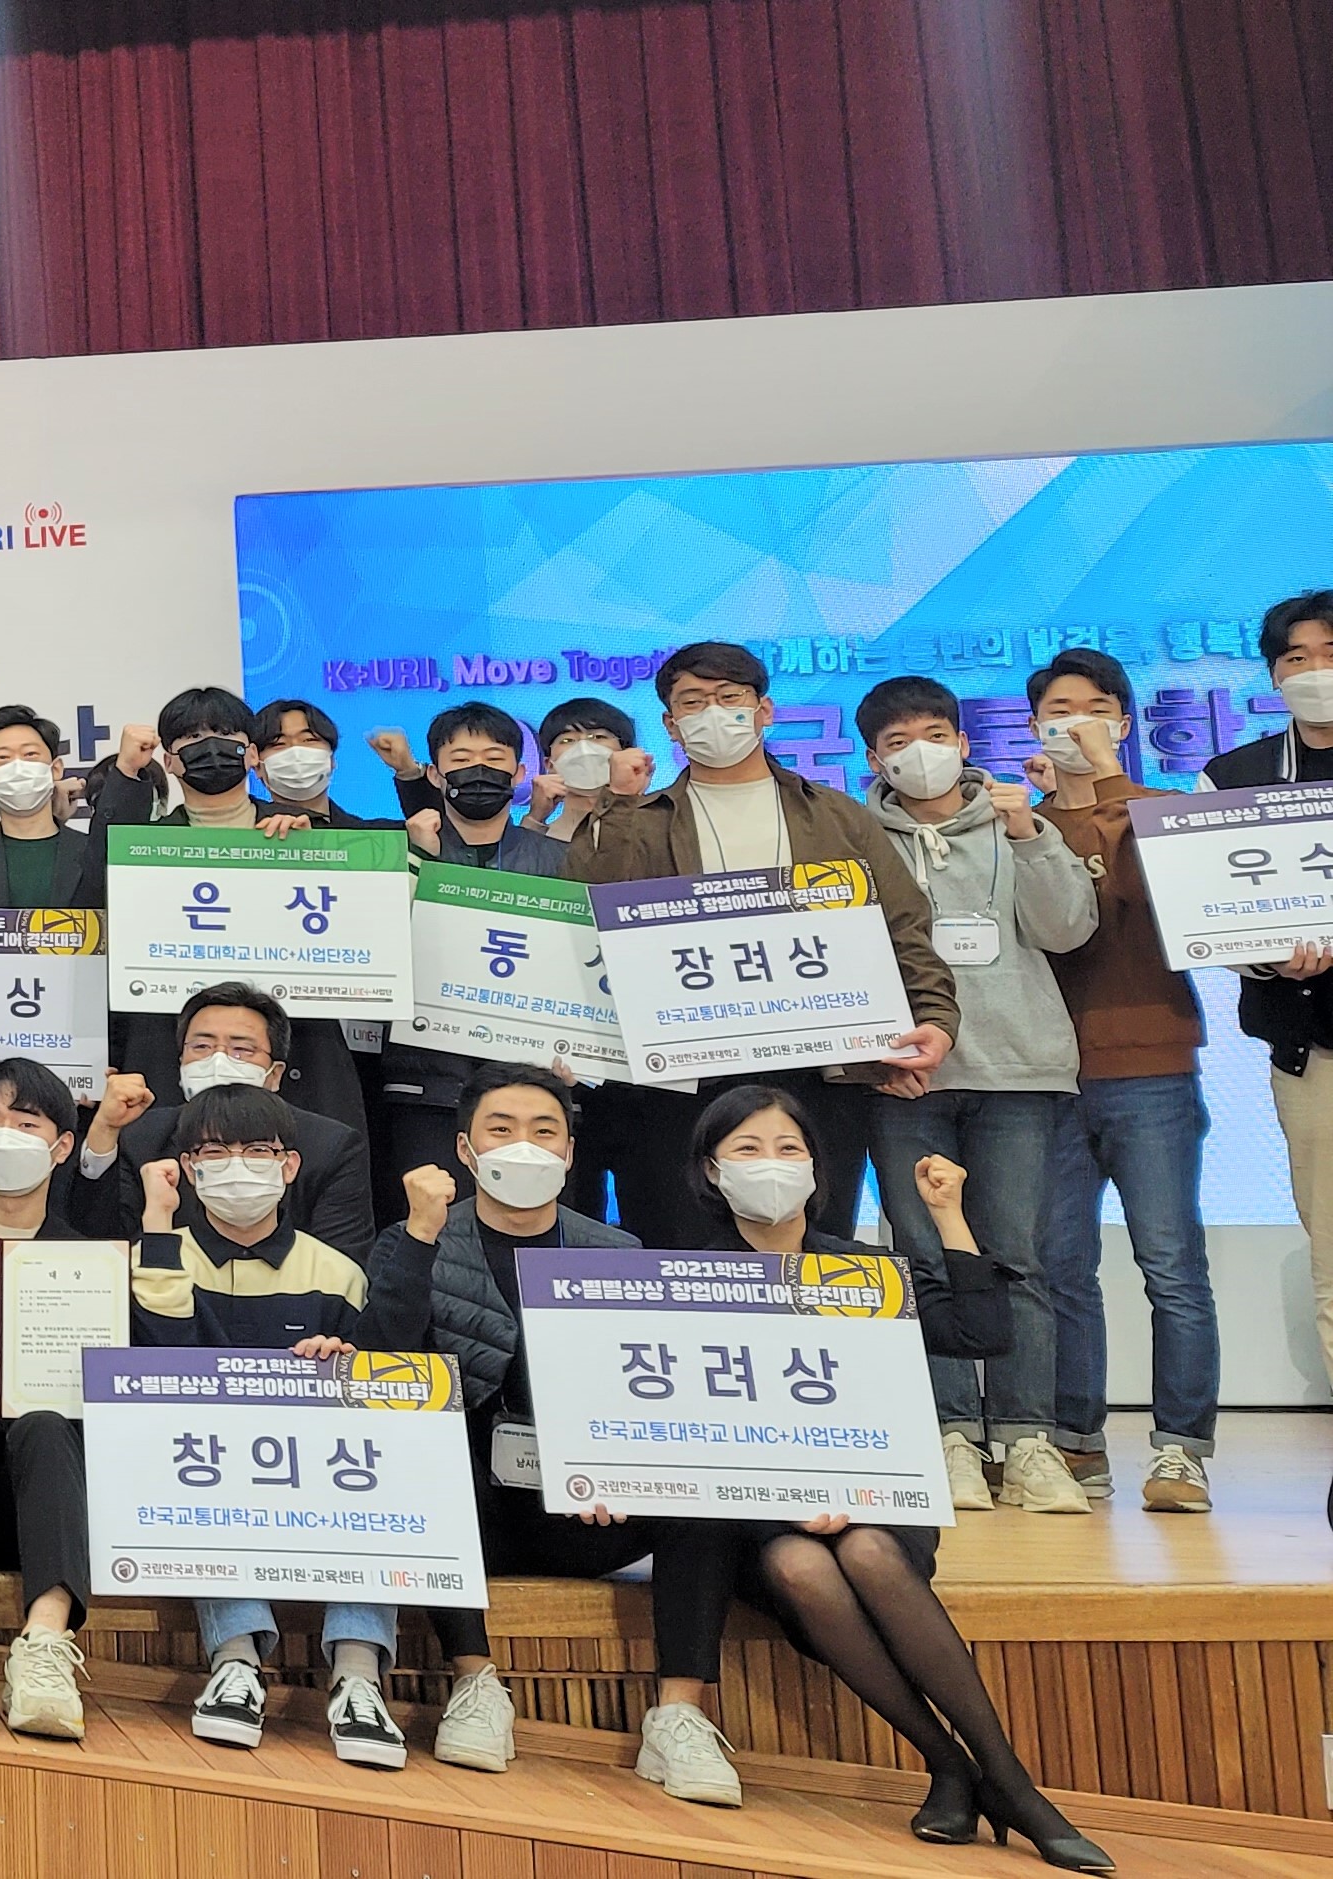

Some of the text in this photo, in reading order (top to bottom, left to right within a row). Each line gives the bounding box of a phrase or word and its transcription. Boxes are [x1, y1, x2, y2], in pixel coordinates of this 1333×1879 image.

[24, 524, 86, 549] LIVE
[453, 652, 557, 686] Move
[183, 847, 347, 862] 교과 캡스톤디자인 교내 경진대회
[693, 876, 769, 896] 2021학년도
[491, 891, 514, 904] 교과
[516, 894, 585, 916] 캡스톤디자인
[617, 884, 854, 923] K+별별상상 창업아이디어 경진대회
[1202, 895, 1326, 918] 한국교통대학교
[27, 932, 83, 948] 경진대회
[149, 943, 371, 965] 한국교통대학교 LINC+사업단장상
[441, 982, 528, 1010] 한국교통대학교
[657, 991, 870, 1025] 한국교통대학교 LINC+사업단장상
[432, 1022, 460, 1035] 교육부
[659, 1260, 765, 1280] 2021학년도
[553, 1279, 664, 1301] K+별별상상
[671, 1280, 793, 1305] 창업아이디어
[798, 1282, 882, 1309] 경진대회
[217, 1357, 317, 1376] 2021학년도
[113, 1375, 429, 1402] K+별별상상 창업아이디어 경진대회
[589, 1420, 890, 1450] 한국교통대학교 LINC+사업단장상
[597, 1480, 830, 1505] 국립한국교통대학교 창업지원·교육센터
[137, 1506, 427, 1534] 한국교통대학교 LINC+사업단장상
[141, 1562, 364, 1586] 국립한국교통대학교 창업지원·교육센터
